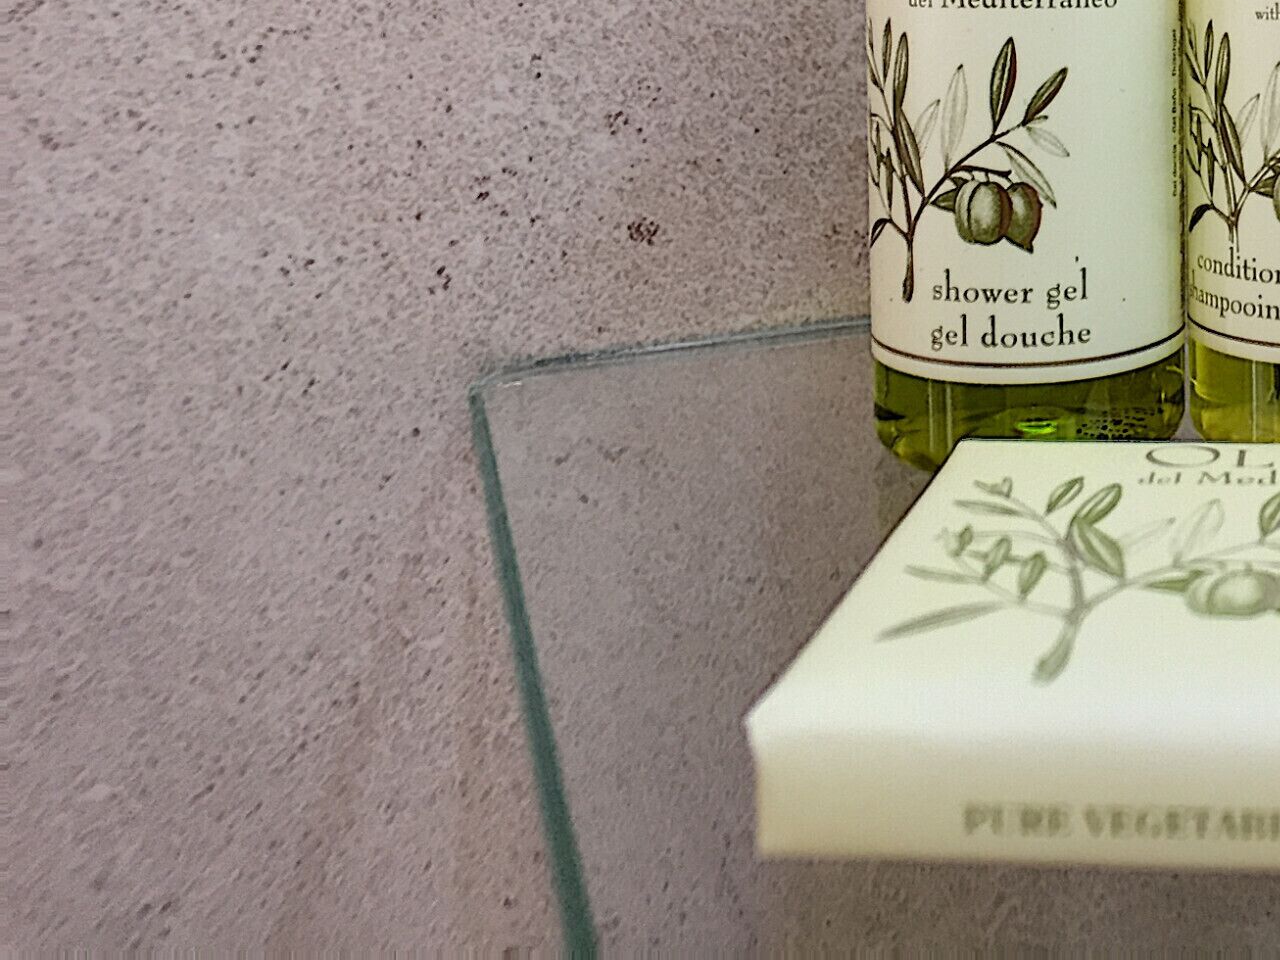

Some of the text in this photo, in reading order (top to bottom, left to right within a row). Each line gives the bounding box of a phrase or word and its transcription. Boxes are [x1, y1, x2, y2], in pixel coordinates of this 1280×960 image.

[932, 267, 1088, 310] shower gel
[930, 313, 1092, 351] gel douche
[1137, 471, 1182, 486] del
[963, 803, 1068, 839] PURE
